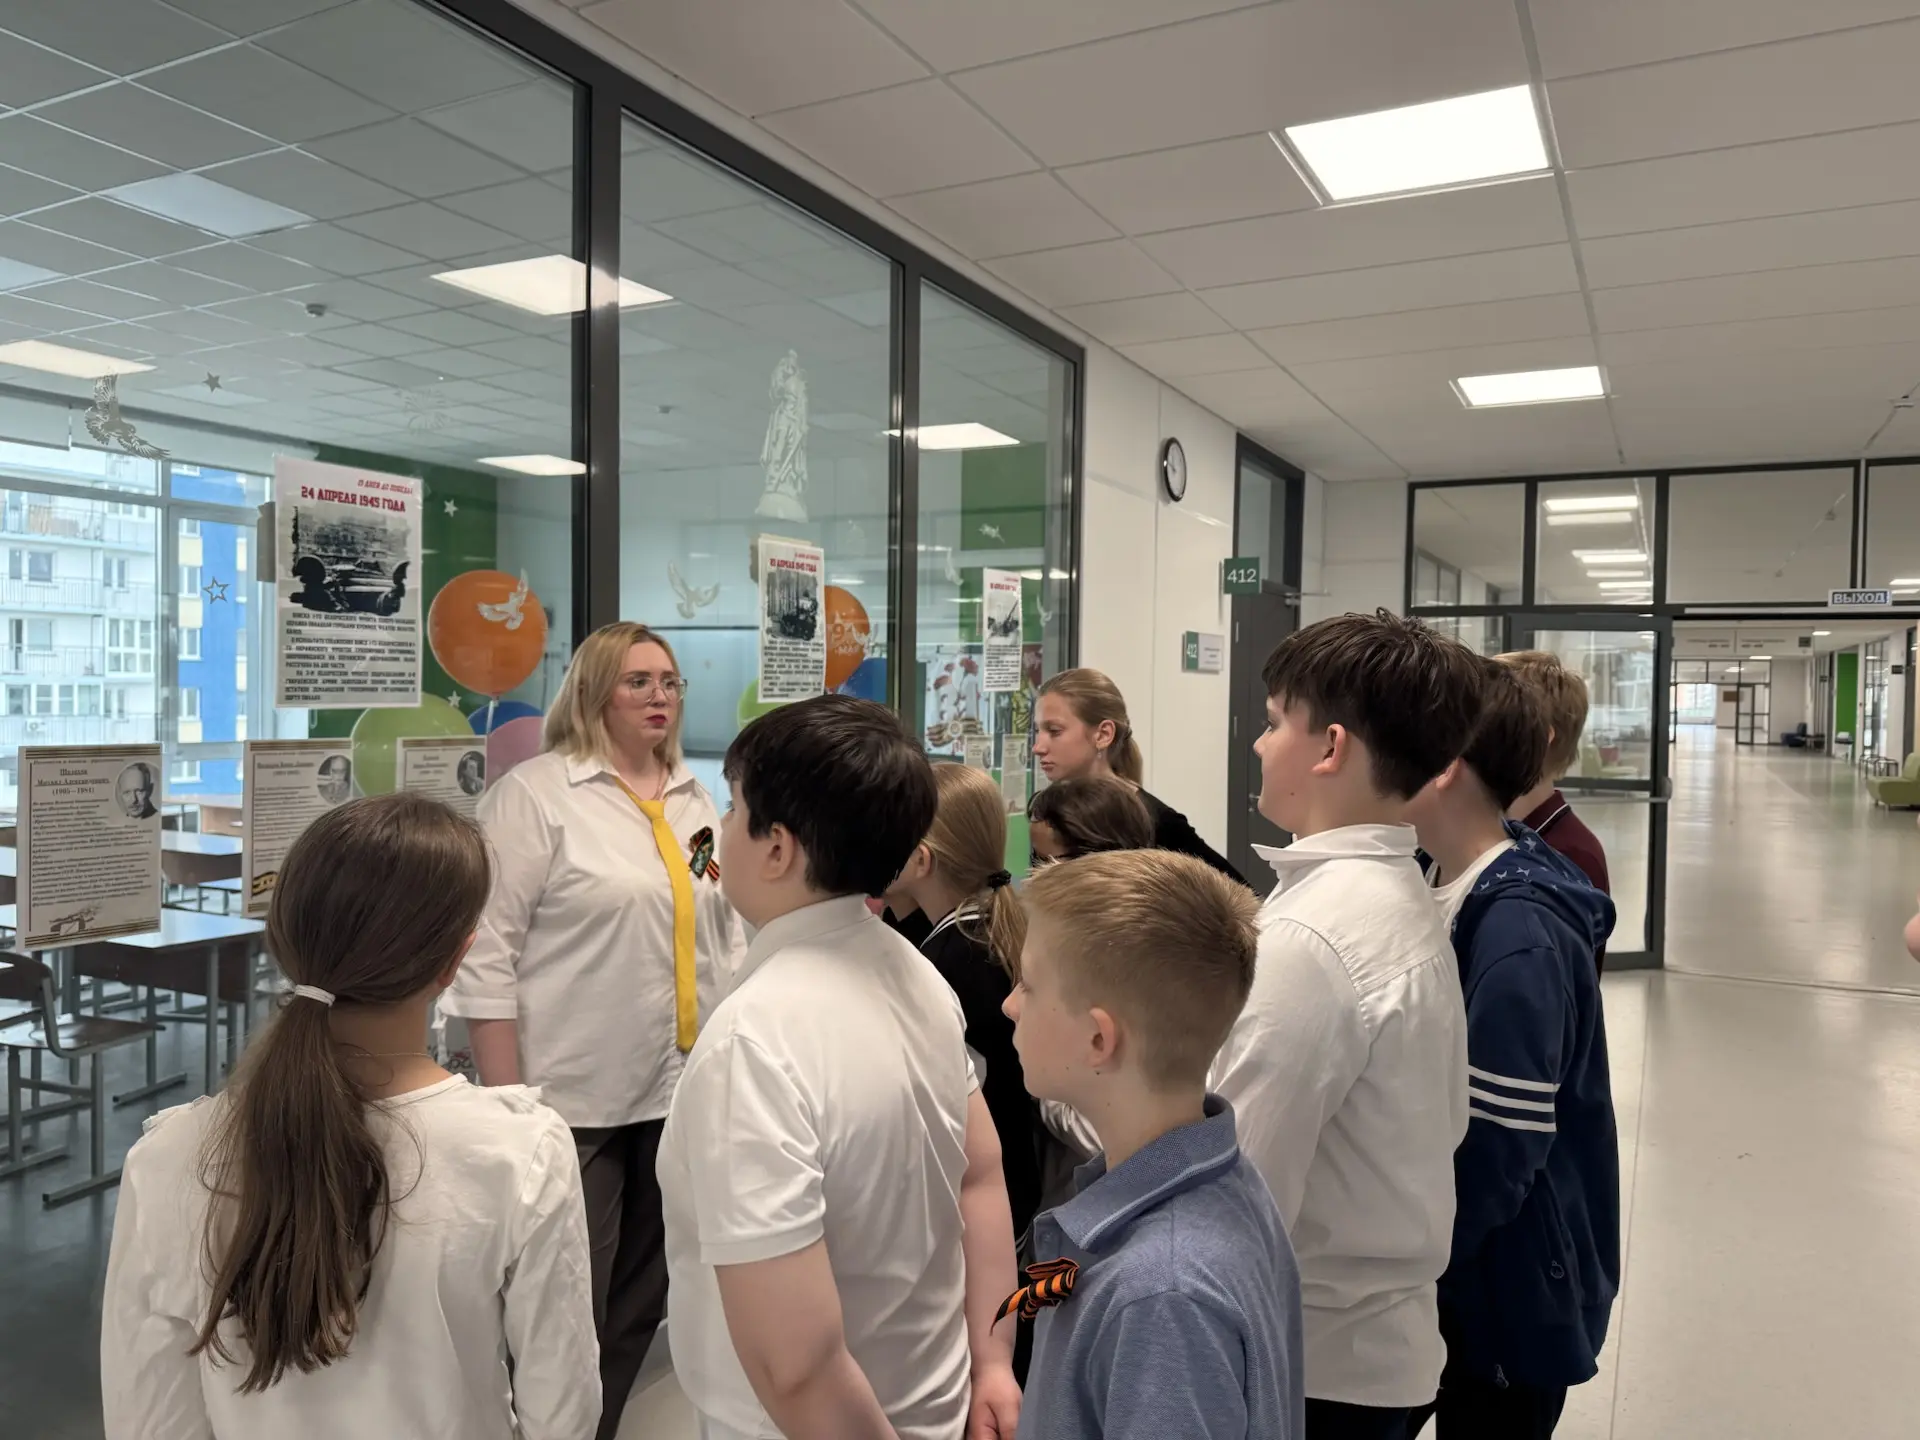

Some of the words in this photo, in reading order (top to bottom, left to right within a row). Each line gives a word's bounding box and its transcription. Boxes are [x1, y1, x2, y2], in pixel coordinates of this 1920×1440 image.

[301, 486, 315, 500] 24
[317, 488, 357, 505] АПРЕЛЯ
[360, 495, 380, 508] 1945
[382, 498, 406, 512] ГОДА
[1227, 568, 1257, 583] 412
[1833, 592, 1886, 604] ВЫХОД
